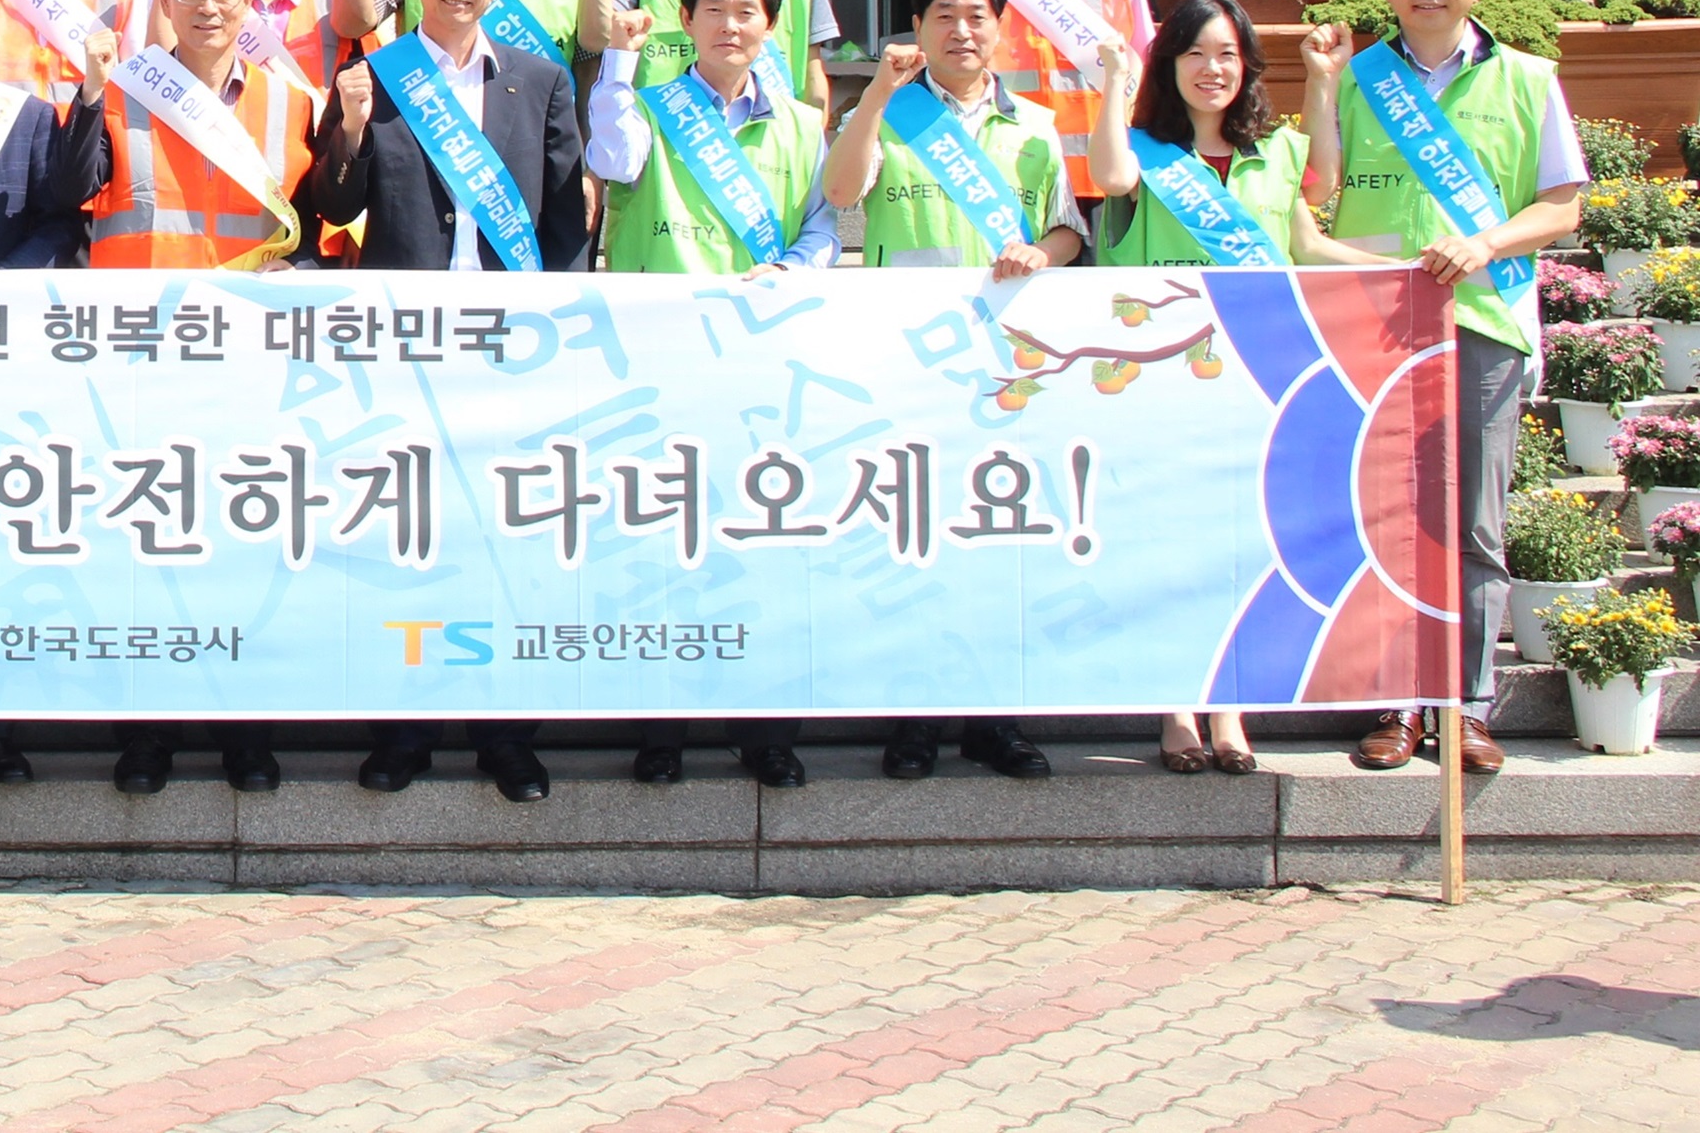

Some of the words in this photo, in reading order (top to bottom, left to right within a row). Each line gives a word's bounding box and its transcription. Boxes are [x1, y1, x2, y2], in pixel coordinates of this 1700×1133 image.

[125, 54, 206, 122] 화요일은
[1372, 69, 1434, 139] 전좌석
[399, 67, 459, 141] 교통사고
[440, 129, 484, 176] 없는
[466, 164, 525, 241] 대한민국
[656, 81, 717, 148] 교통사고
[696, 136, 740, 184] 없는
[721, 172, 777, 249] 대한민국
[926, 131, 999, 205] 전좌석
[1155, 159, 1232, 230] 전좌석
[653, 220, 715, 241] SAFETY
[44, 302, 230, 365] 행복한
[263, 304, 510, 366] 대한민국
[494, 442, 1095, 561] 다녀오세요!
[383, 622, 494, 667] TS
[511, 622, 750, 664] 교통안전공단
